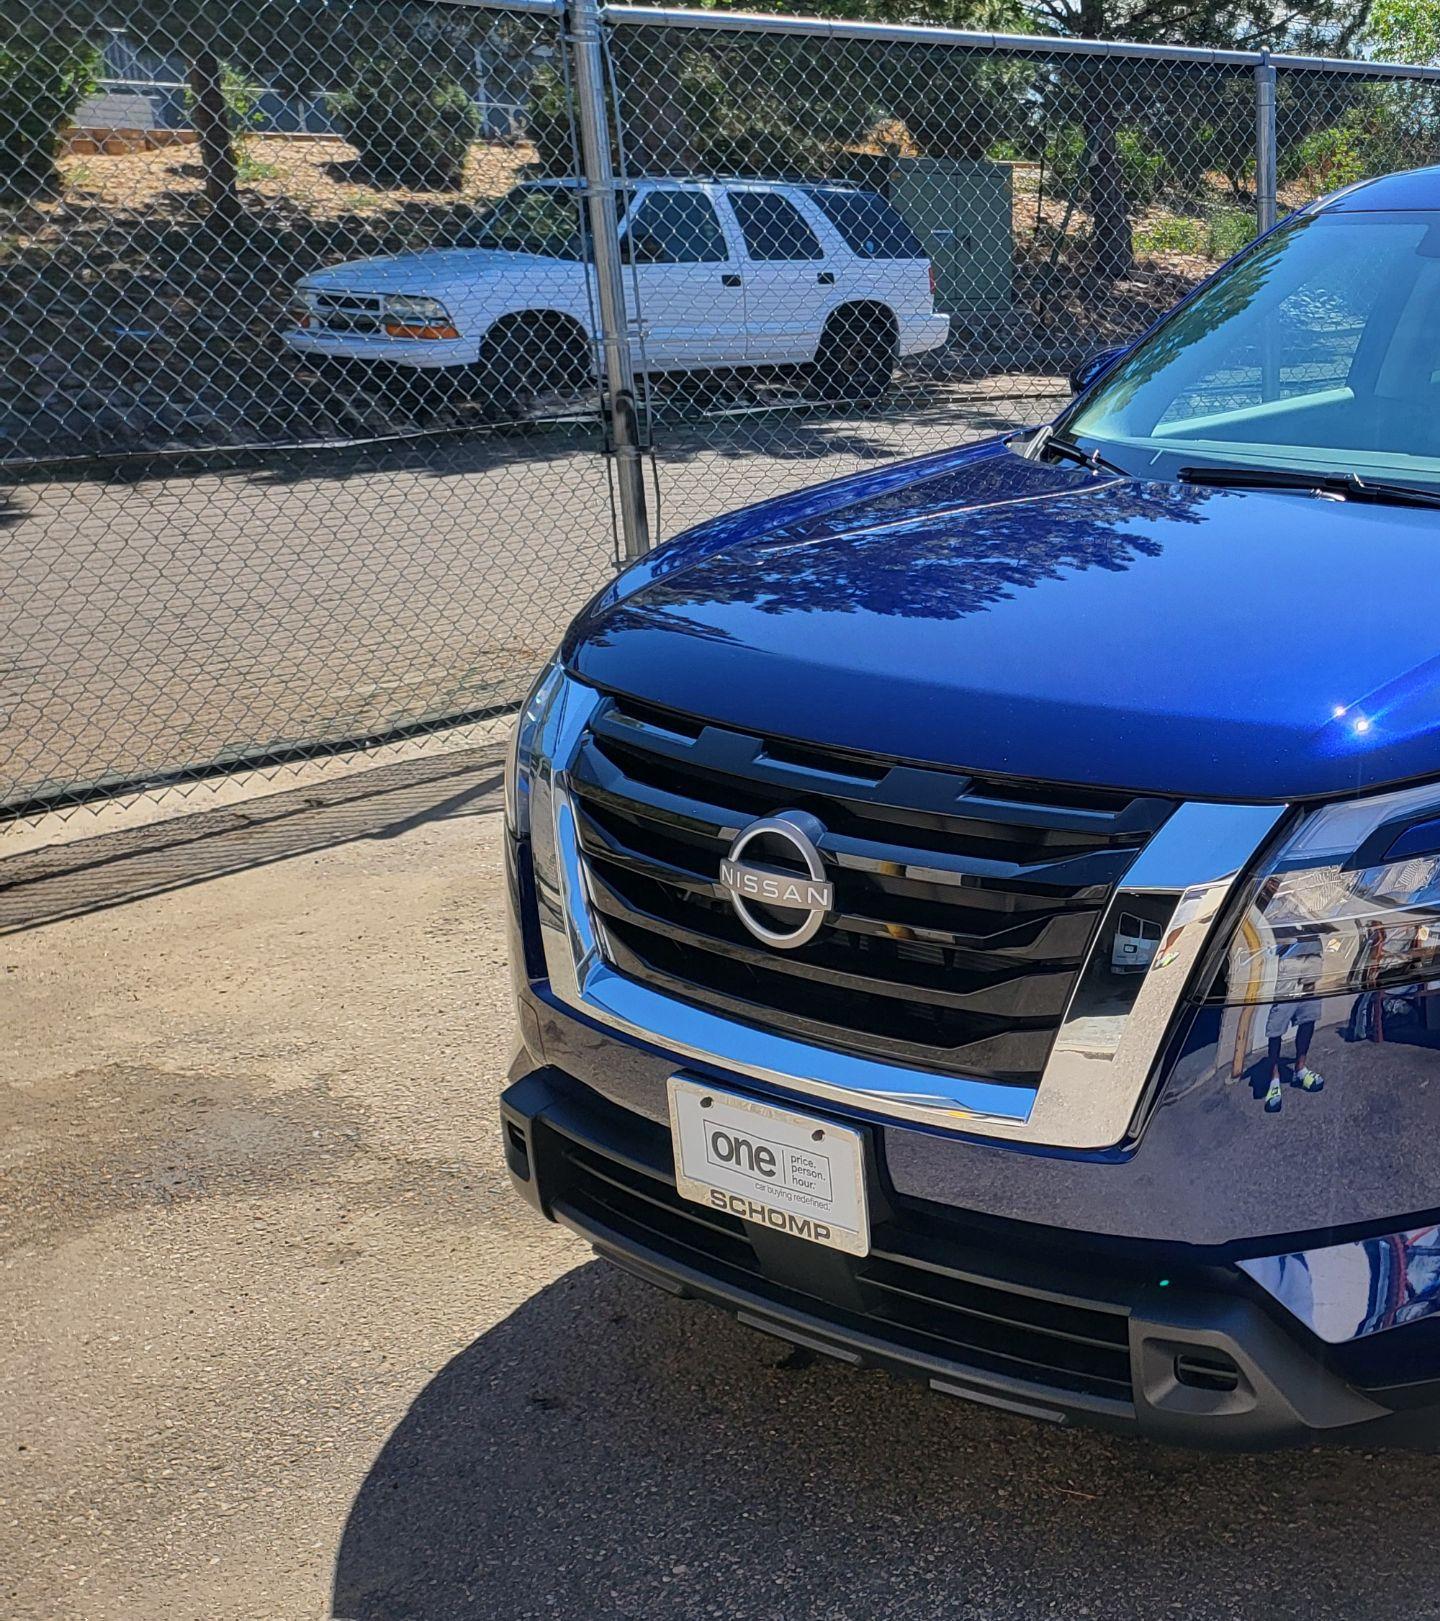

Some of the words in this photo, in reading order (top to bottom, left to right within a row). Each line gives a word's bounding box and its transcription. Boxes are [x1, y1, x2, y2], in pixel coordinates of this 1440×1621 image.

[721, 864, 828, 906] NISSAN
[711, 1131, 777, 1178] one
[790, 1155, 816, 1169] price.
[791, 1165, 826, 1181] person.
[755, 1182, 766, 1191] car
[767, 1185, 793, 1201] buying
[710, 1189, 831, 1240] SCHOMP
